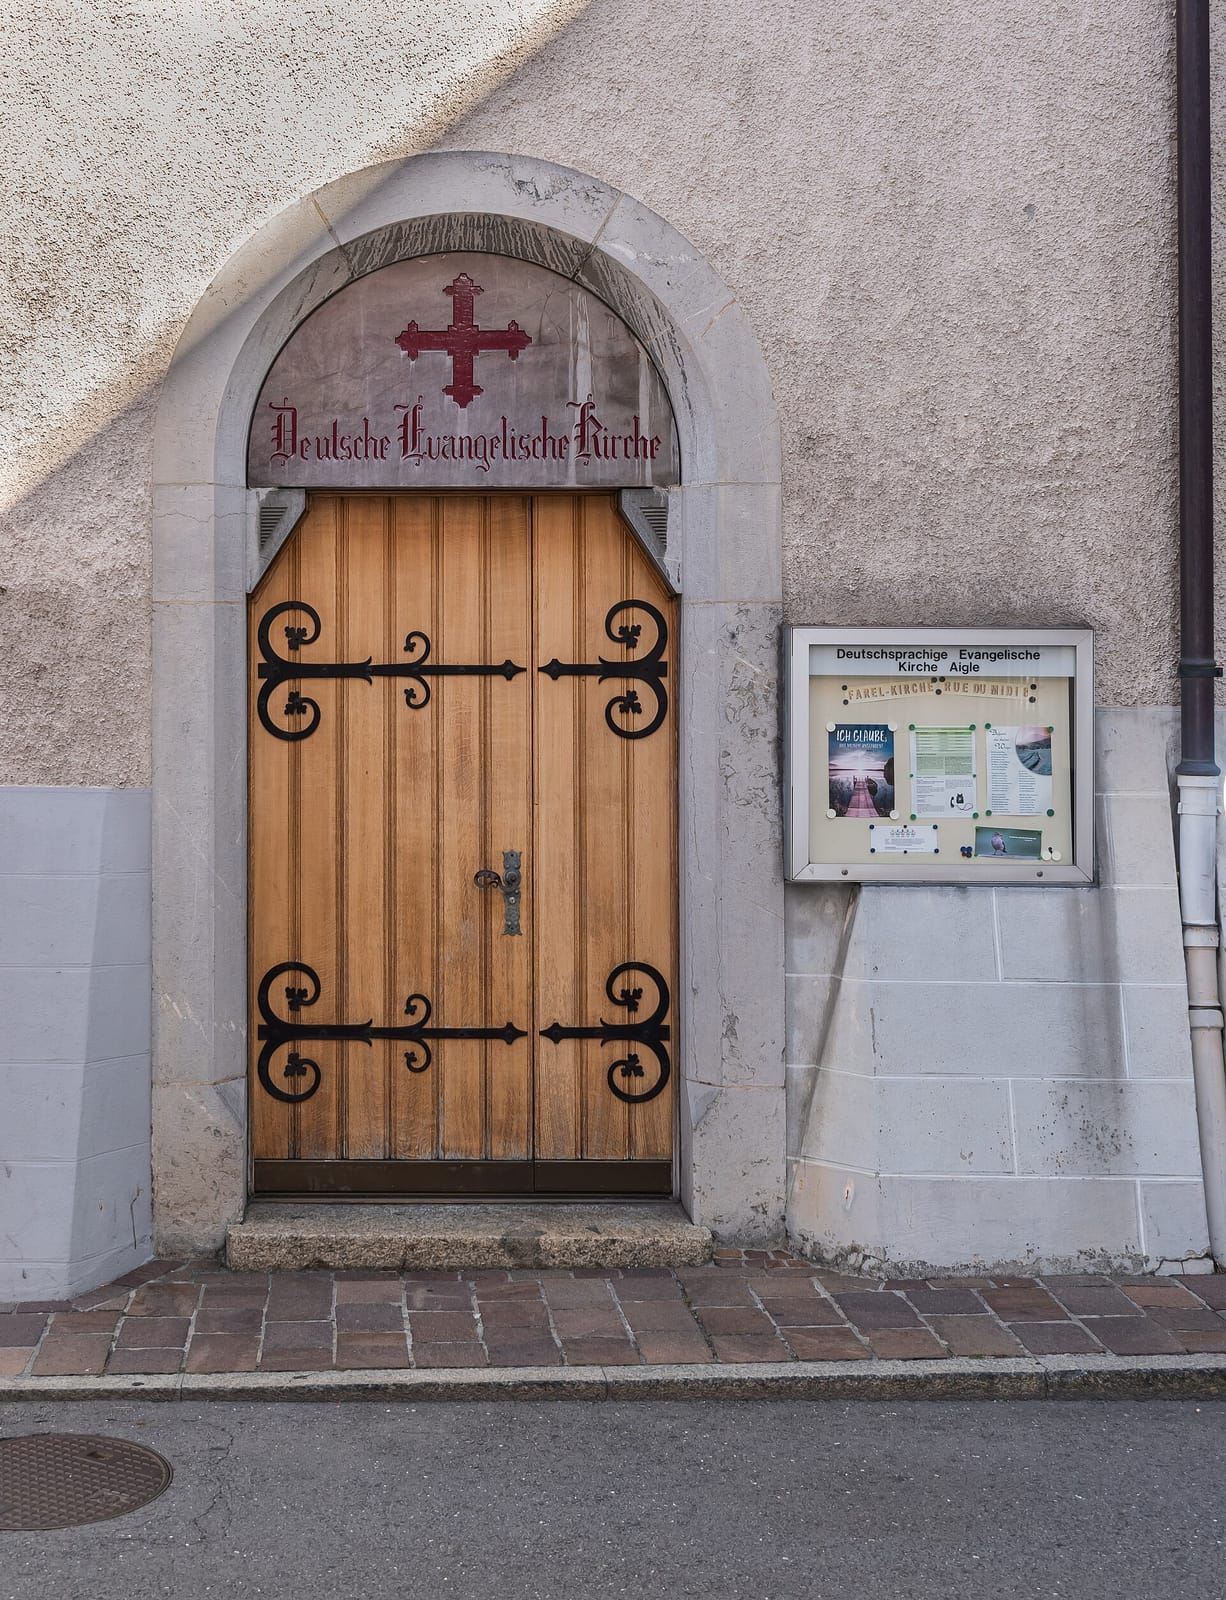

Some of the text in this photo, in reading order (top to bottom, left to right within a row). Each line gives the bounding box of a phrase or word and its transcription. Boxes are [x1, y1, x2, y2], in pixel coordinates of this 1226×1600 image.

[269, 393, 662, 472] Deutsche Evangelische Kirche
[837, 648, 1040, 662] Deutschsprachige Evangelische
[898, 661, 980, 674] Kirche Aigle
[848, 682, 934, 700] FAREL-KIRCHE
[944, 682, 969, 692] RUE
[973, 684, 985, 693] DU
[991, 686, 1018, 696] MIDI
[837, 730, 850, 741] ICH
